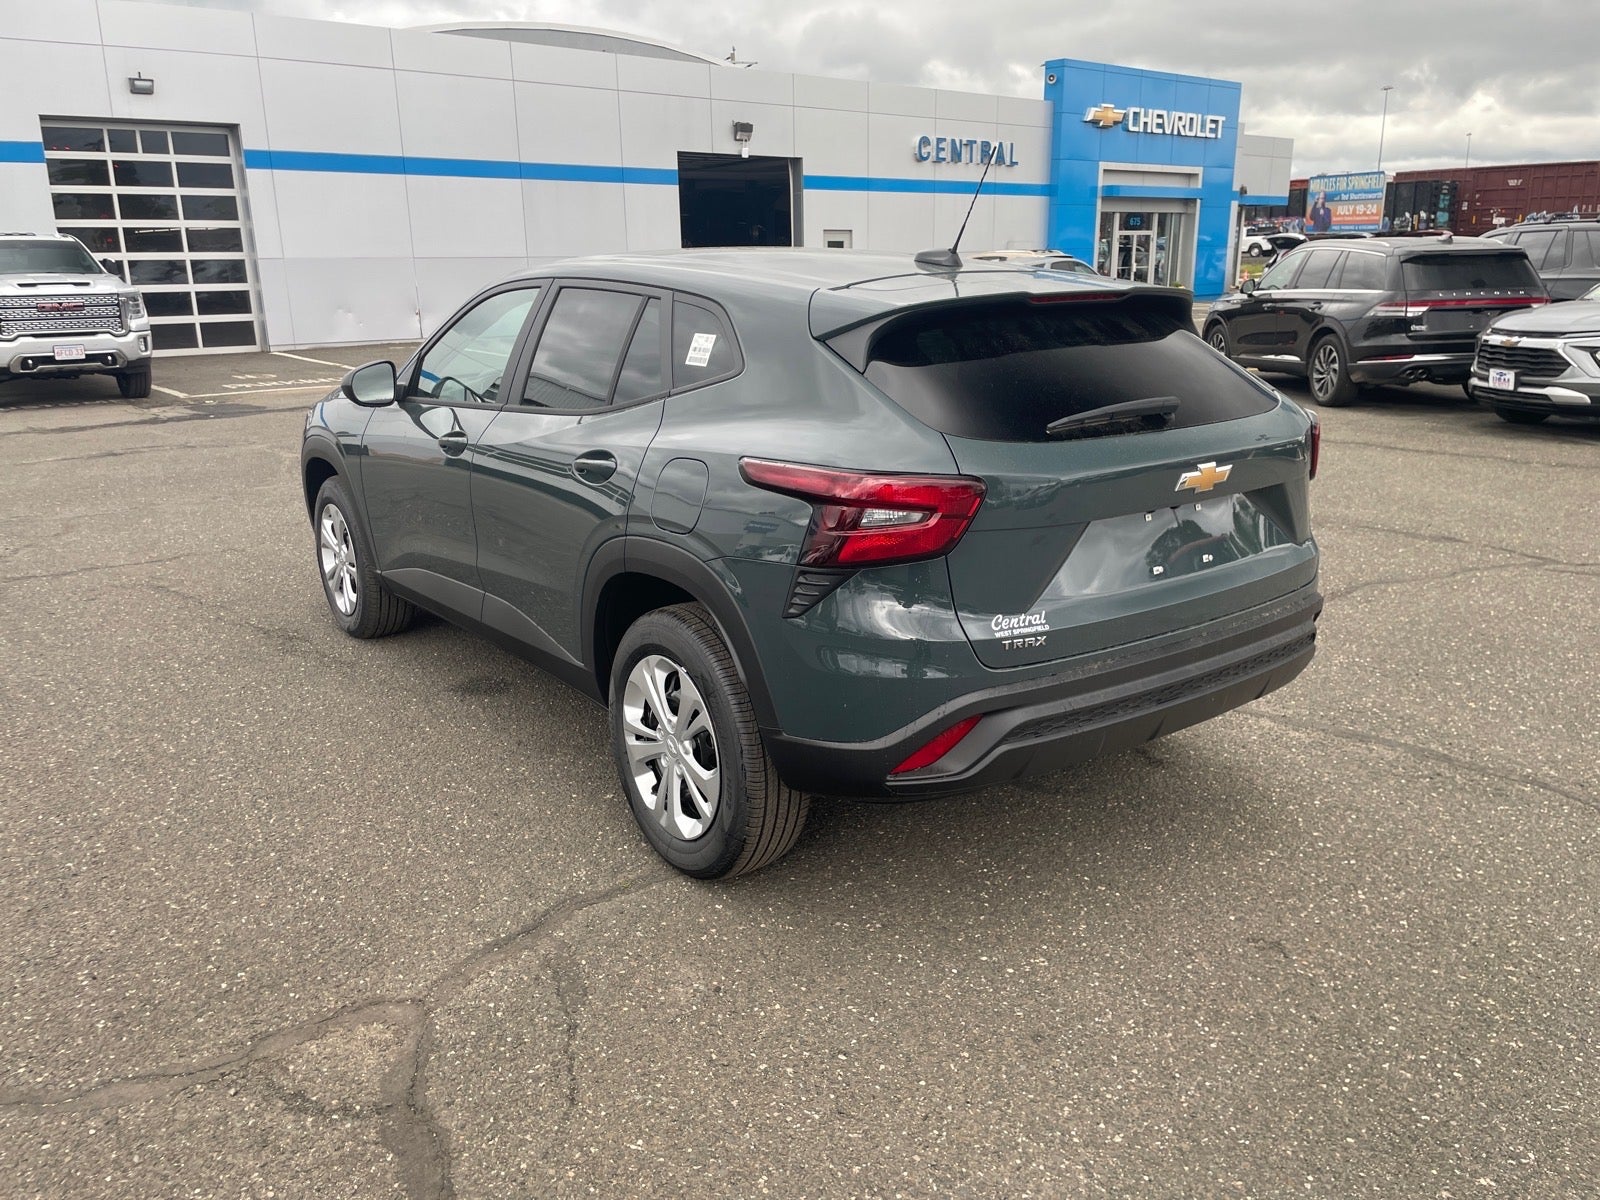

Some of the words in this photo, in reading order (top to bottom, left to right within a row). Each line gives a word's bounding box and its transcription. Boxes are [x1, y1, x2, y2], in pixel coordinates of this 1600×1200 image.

[1126, 106, 1226, 139] CHEVROLET
[914, 135, 1019, 167] CENTRAL
[1310, 177, 1336, 193] MIRACLES
[1336, 177, 1348, 192] FOR
[1348, 174, 1384, 190] SPRINGFIELD
[1336, 204, 1355, 215] JULY
[1356, 203, 1377, 214] 19-24
[1129, 217, 1141, 226] 675
[37, 302, 84, 312] GMC
[991, 610, 1046, 631] Central
[994, 630, 1012, 638] WEST
[1013, 625, 1050, 635] SPRINGFIELD
[1001, 635, 1047, 651] TRAX
